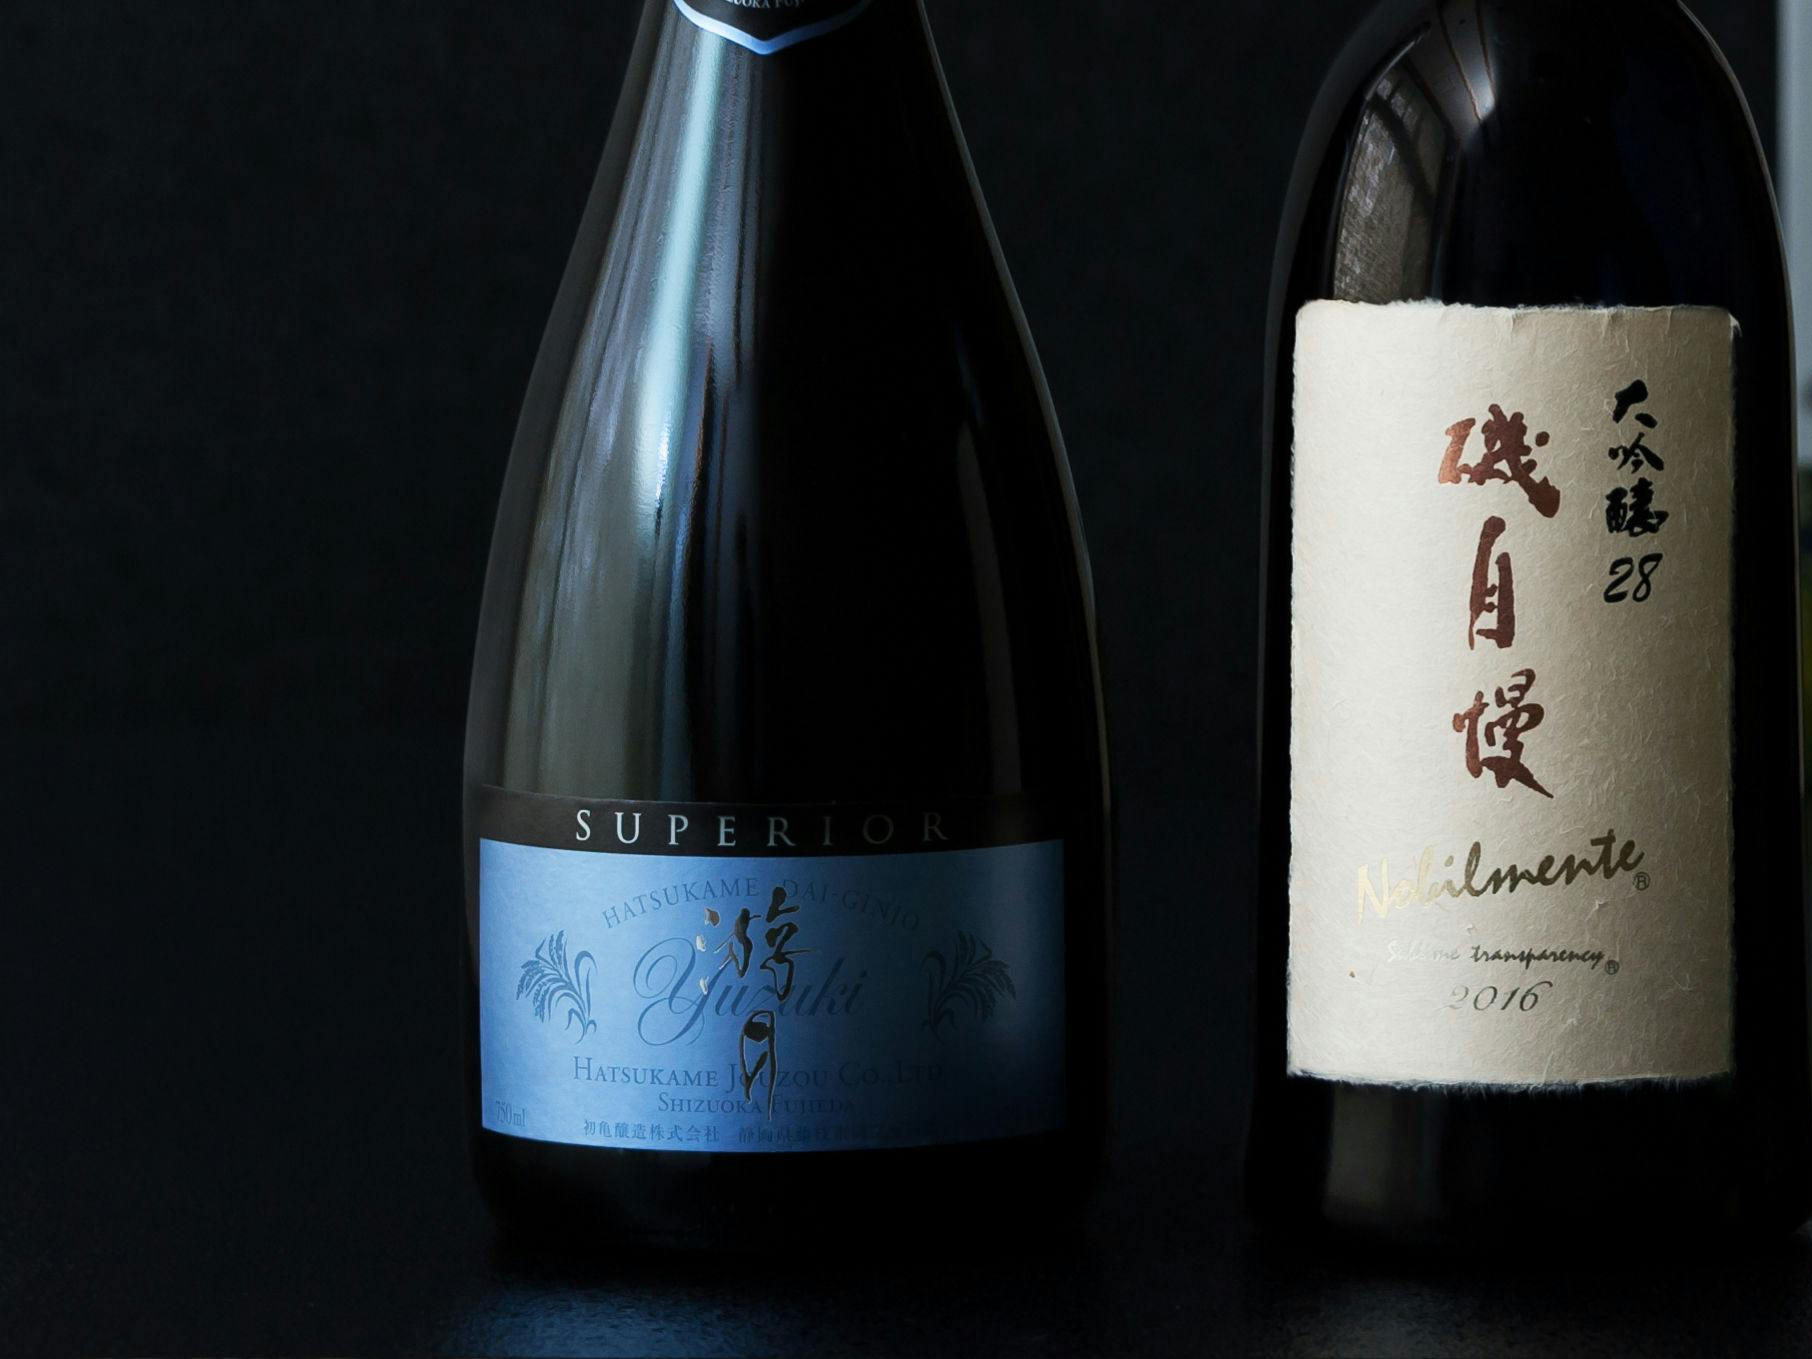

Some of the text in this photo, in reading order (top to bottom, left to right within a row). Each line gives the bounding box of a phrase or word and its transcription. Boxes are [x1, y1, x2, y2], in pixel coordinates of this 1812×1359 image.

[1437, 403, 1561, 800] 磯自慢
[574, 807, 950, 848] SUPERIOR
[600, 877, 921, 932] HATSUKAME DAI-GINJO
[632, 936, 869, 1048] Yuzuki
[1435, 980, 1554, 1013] 2016
[572, 1055, 719, 1088] HATSUKAME
[726, 1061, 830, 1093] JOUZOU
[656, 1091, 762, 1115] SHIZUOKA
